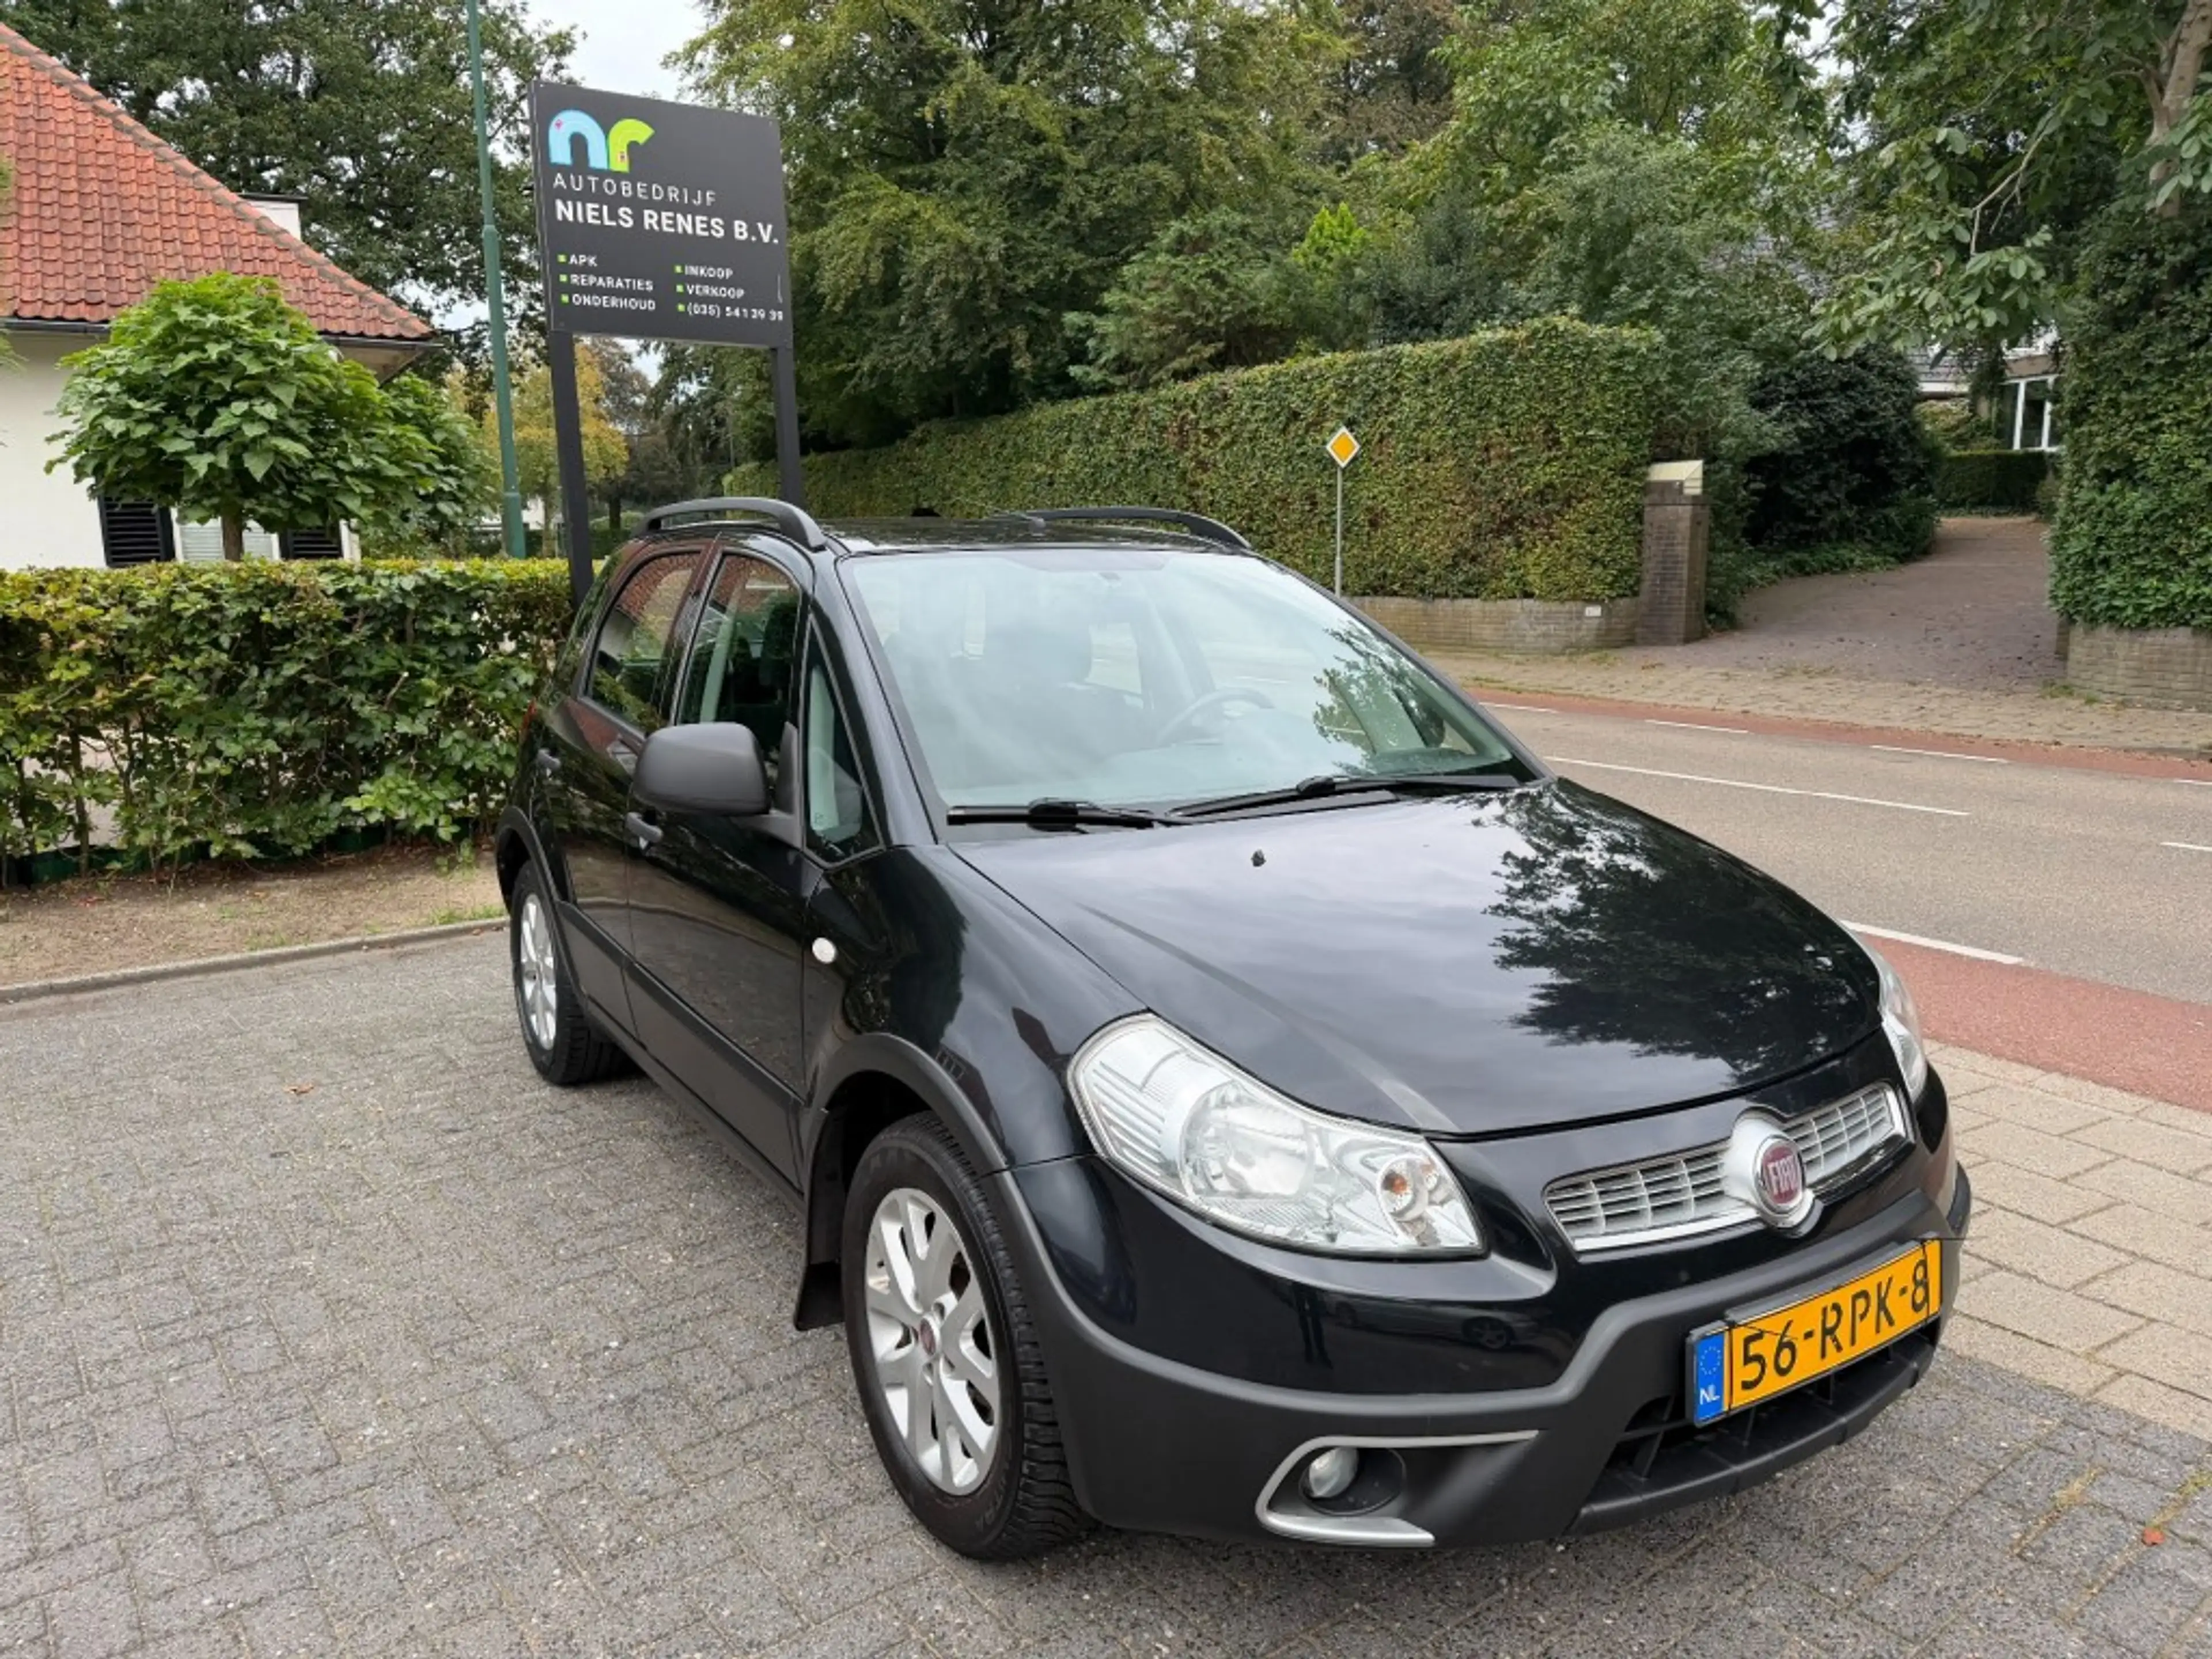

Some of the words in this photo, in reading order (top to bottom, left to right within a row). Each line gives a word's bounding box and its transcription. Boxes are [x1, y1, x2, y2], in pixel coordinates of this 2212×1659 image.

[553, 172, 717, 206] AUTOBEDRIJF
[555, 199, 634, 228] NIELS
[643, 209, 725, 238] RENES
[734, 219, 779, 244] B.V.
[569, 254, 597, 267] APK
[684, 265, 733, 279] INKOOP
[570, 274, 653, 291] REPARATIES
[686, 283, 744, 299] VERKOOP
[572, 294, 656, 310] ONDERHOUD
[1740, 1259, 1929, 1391] 56-RPK-8
[1699, 1384, 1720, 1404] NL
